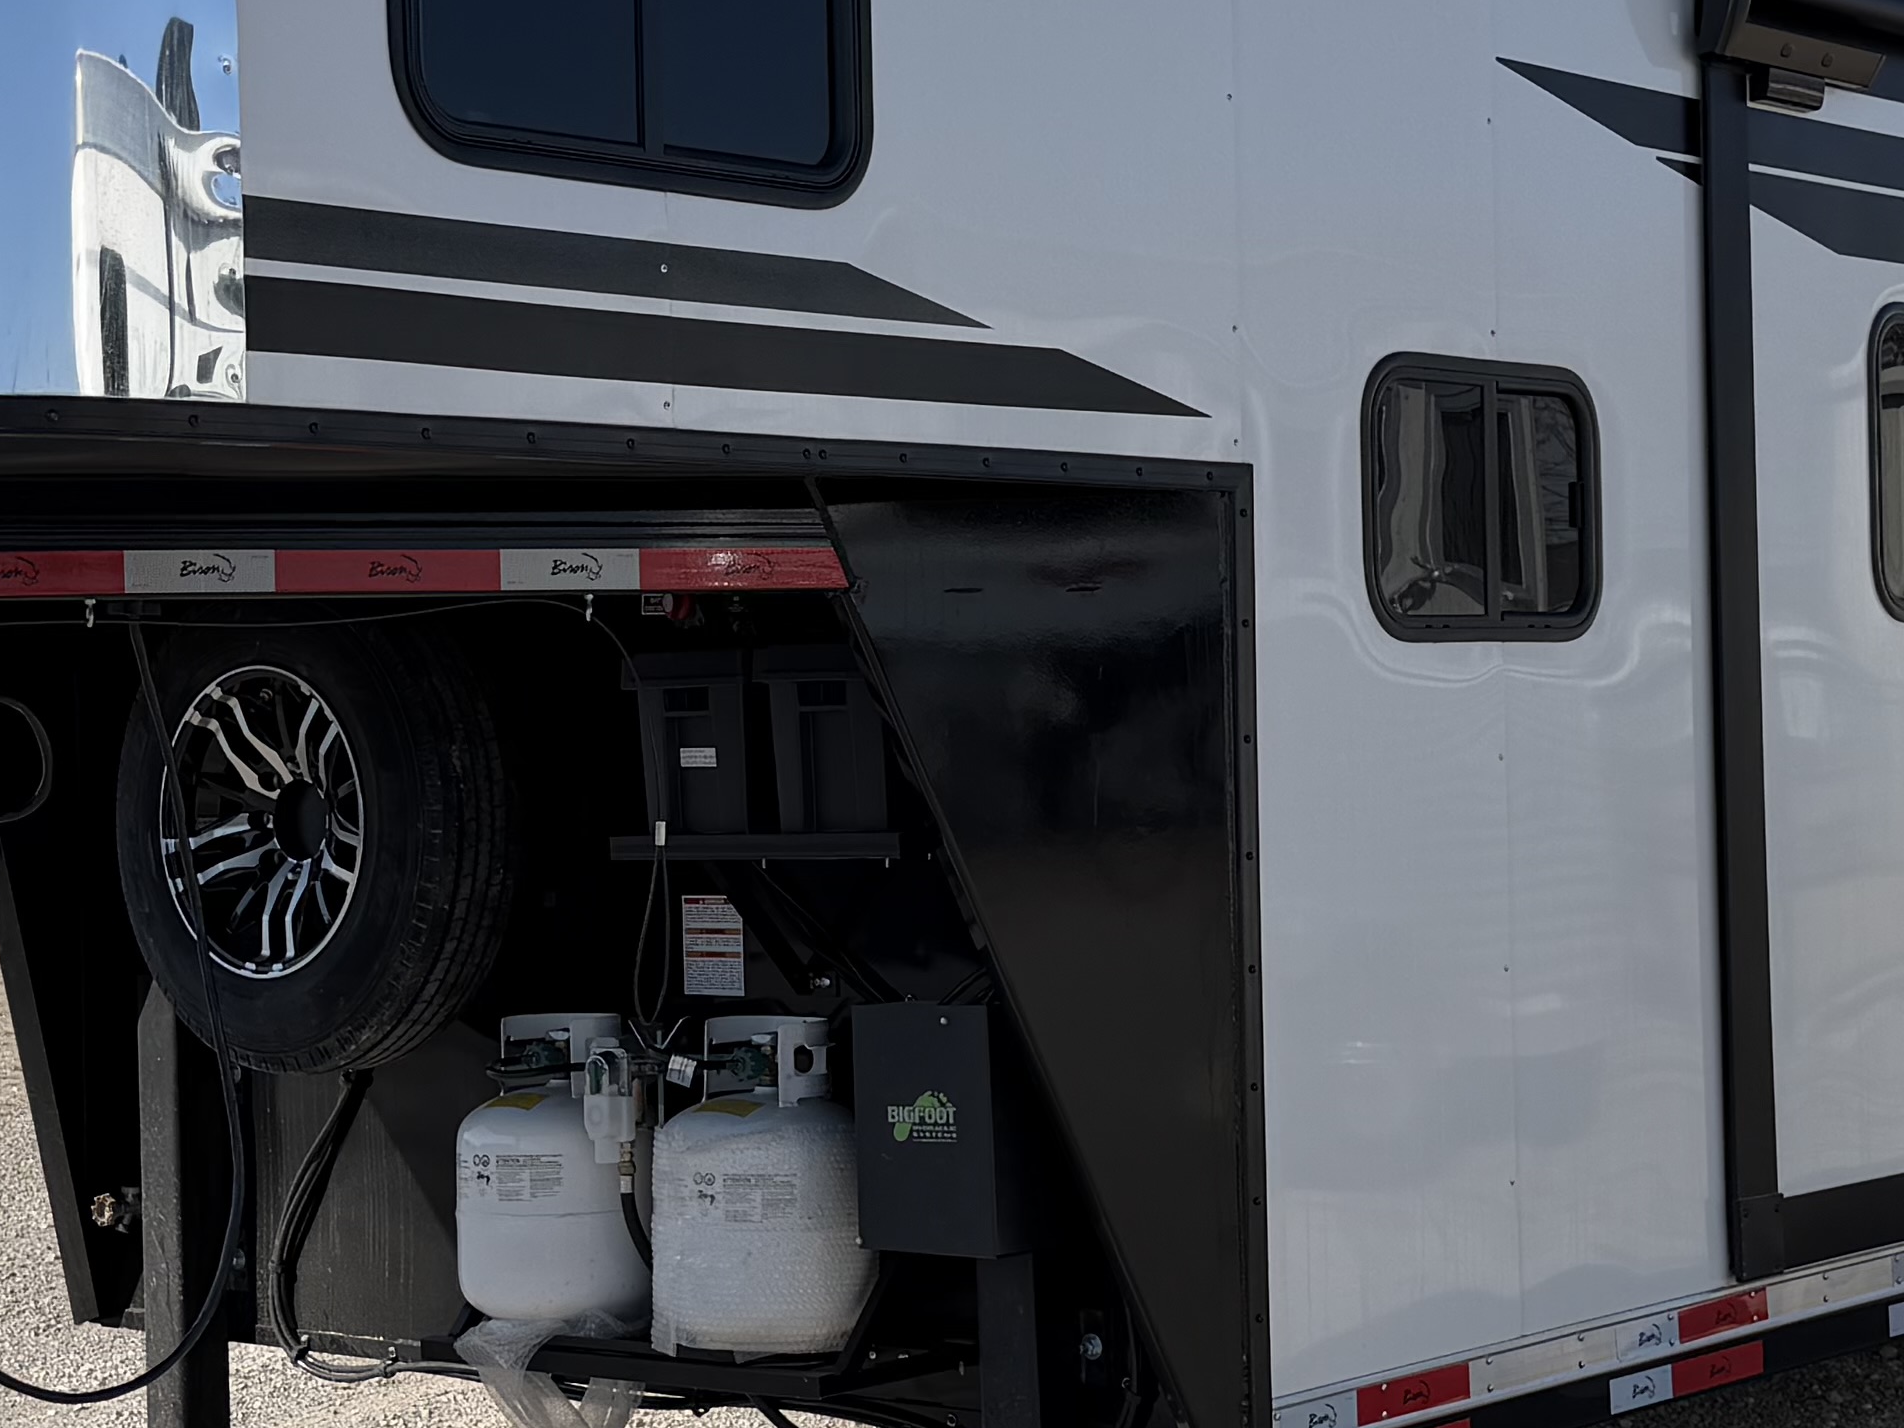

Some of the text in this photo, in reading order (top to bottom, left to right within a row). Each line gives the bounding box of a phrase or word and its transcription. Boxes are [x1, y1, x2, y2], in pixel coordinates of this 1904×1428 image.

[179, 560, 221, 578] Bison
[368, 560, 408, 578] Bison
[551, 559, 590, 576] Bison
[887, 1105, 957, 1124] BIGFOOT
